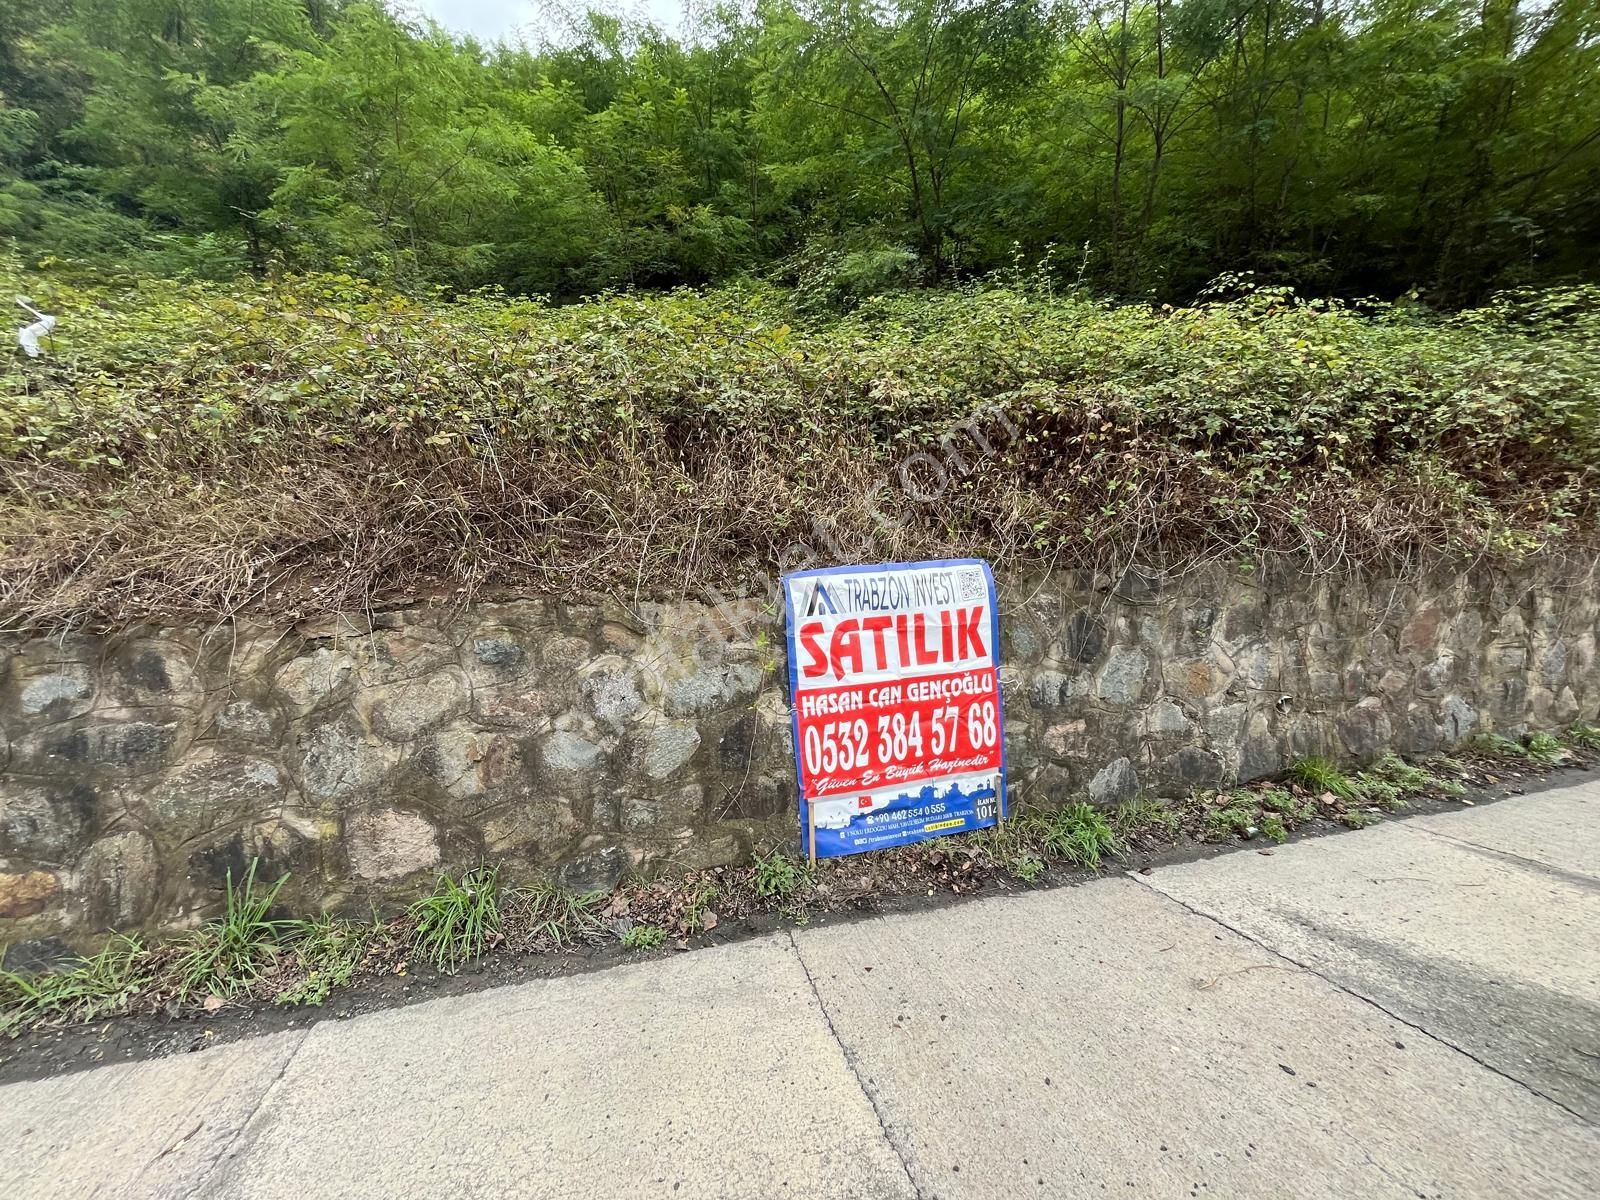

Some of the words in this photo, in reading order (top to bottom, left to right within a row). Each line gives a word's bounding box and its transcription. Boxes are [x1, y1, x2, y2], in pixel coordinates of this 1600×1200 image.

[844, 576, 910, 613] TRABZON
[913, 572, 956, 606] INVEST
[800, 605, 988, 681] SATILIK
[802, 690, 863, 719] HASAN
[869, 685, 902, 709] CAN
[907, 671, 993, 704] GENÇOĞLU
[804, 718, 869, 776] 0532
[877, 711, 923, 763] 384
[931, 705, 959, 756] 57
[968, 701, 996, 750] 68
[861, 770, 880, 785] En
[886, 761, 924, 783] Büyük
[892, 810, 907, 820] 462
[908, 808, 923, 817] 554
[924, 806, 930, 815] 0
[931, 803, 946, 813] 555
